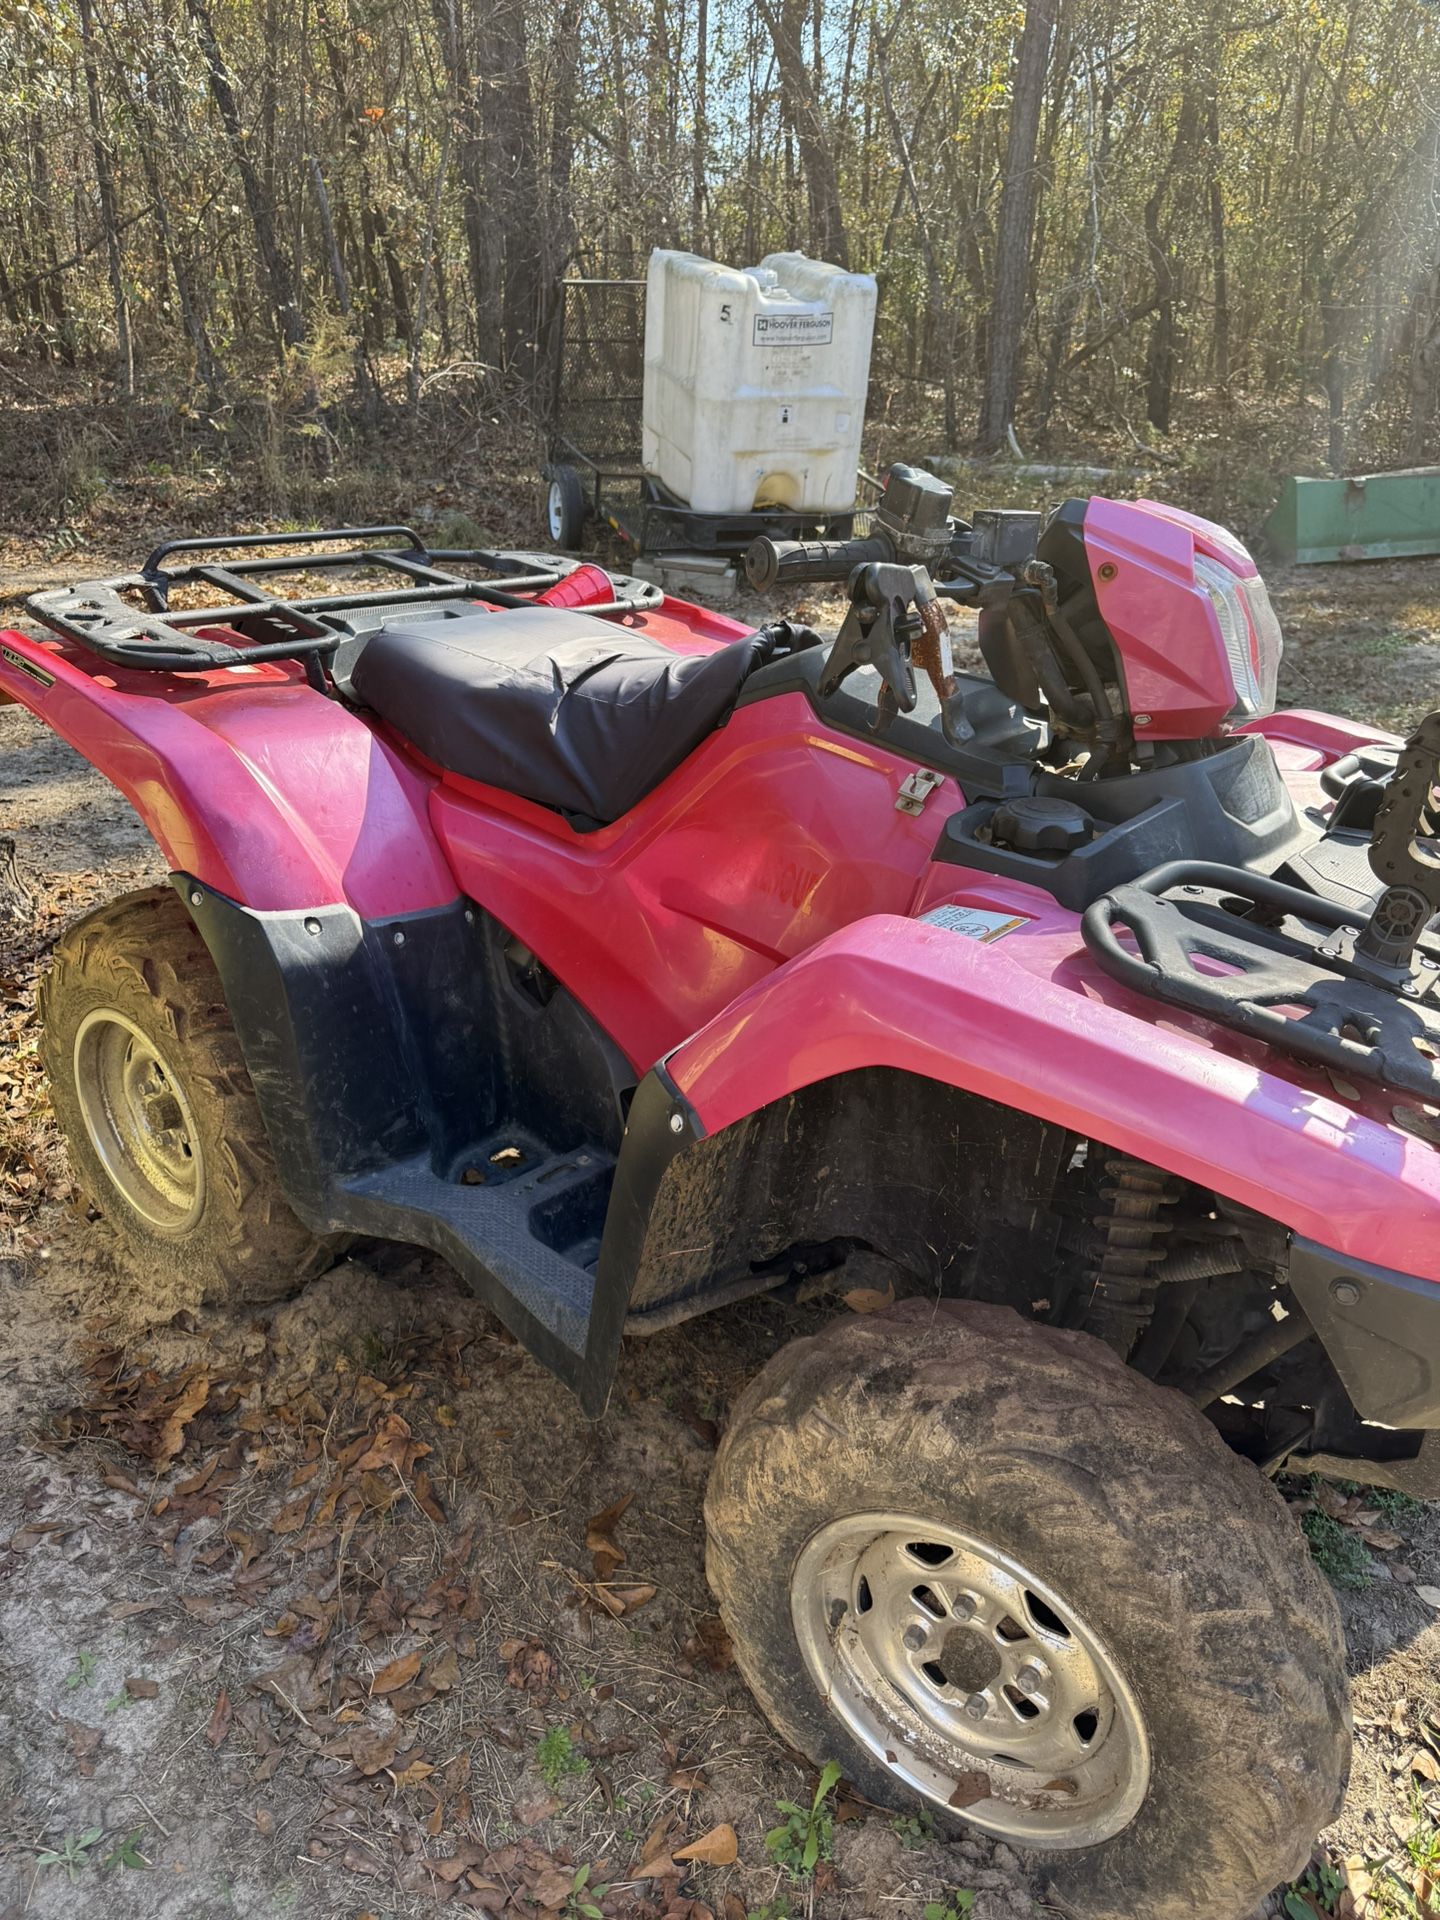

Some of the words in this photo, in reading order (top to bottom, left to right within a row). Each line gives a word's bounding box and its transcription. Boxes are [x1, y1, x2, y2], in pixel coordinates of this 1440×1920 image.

[720, 304, 731, 322] 5
[769, 320, 797, 329] HOOVER
[799, 319, 831, 329] FERGUSON
